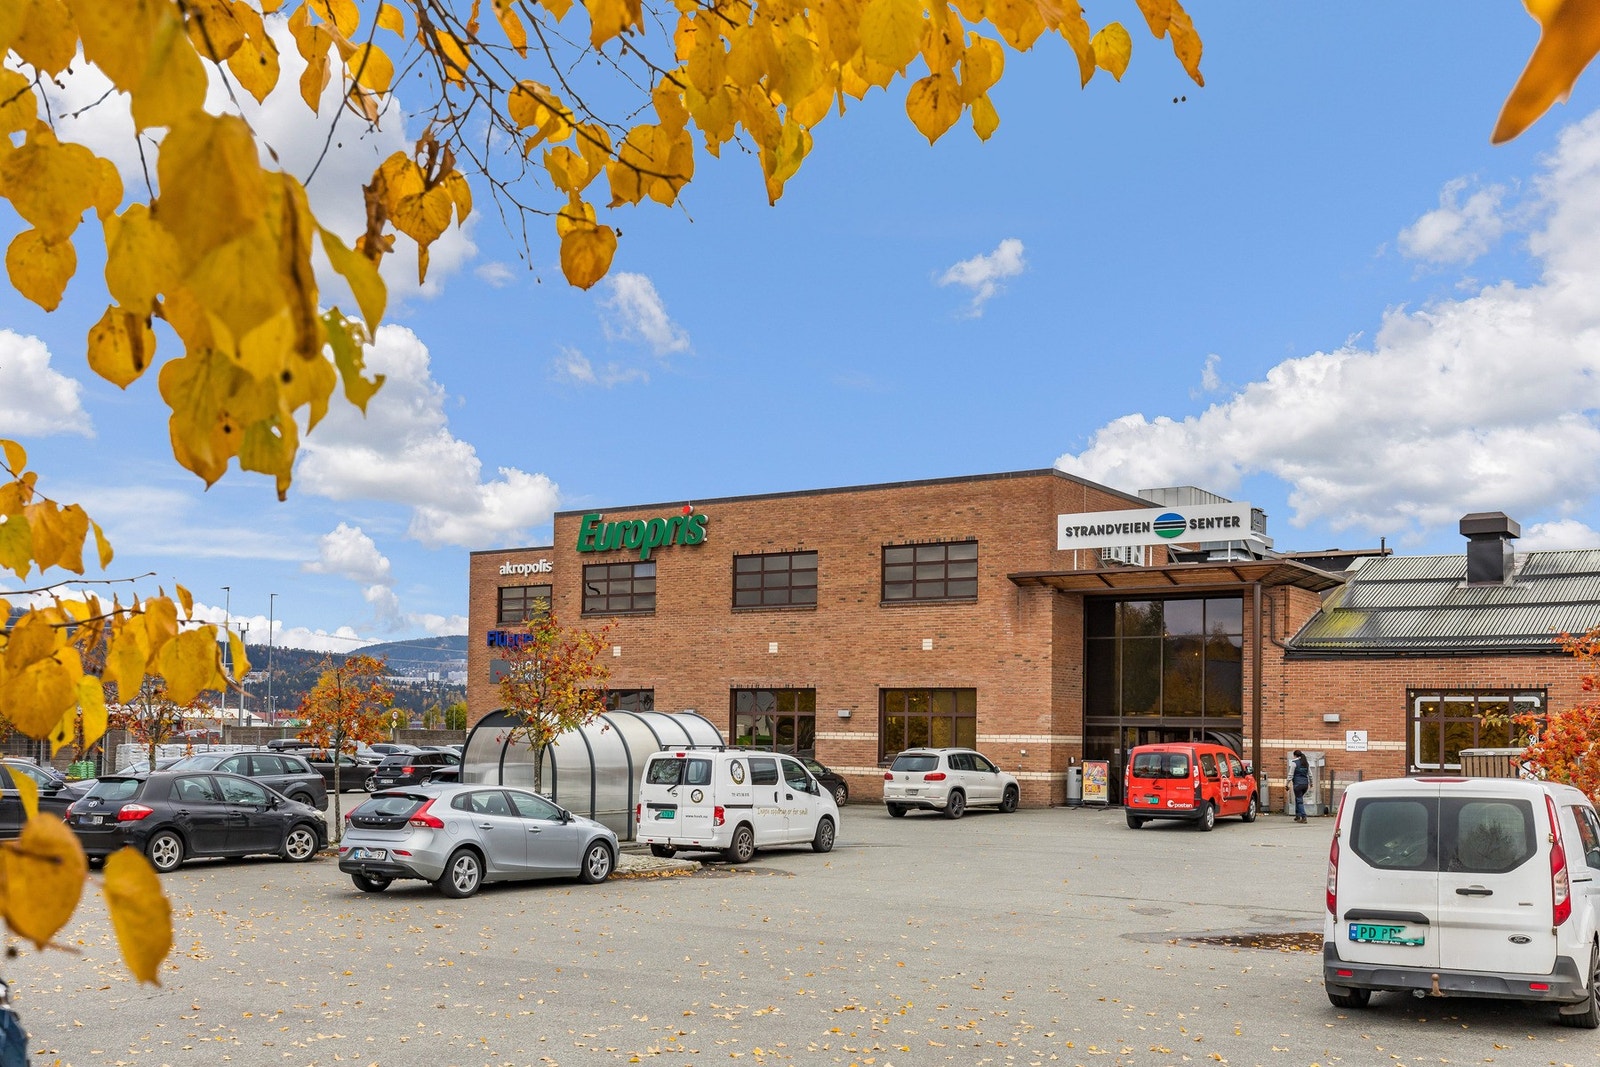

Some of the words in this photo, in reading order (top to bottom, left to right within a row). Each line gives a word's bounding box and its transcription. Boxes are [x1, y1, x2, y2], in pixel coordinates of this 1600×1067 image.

[575, 505, 708, 559] Europris
[1065, 522, 1150, 537] STRANDVEIEN
[1189, 516, 1241, 530] SENTER
[499, 559, 553, 576] akropolis
